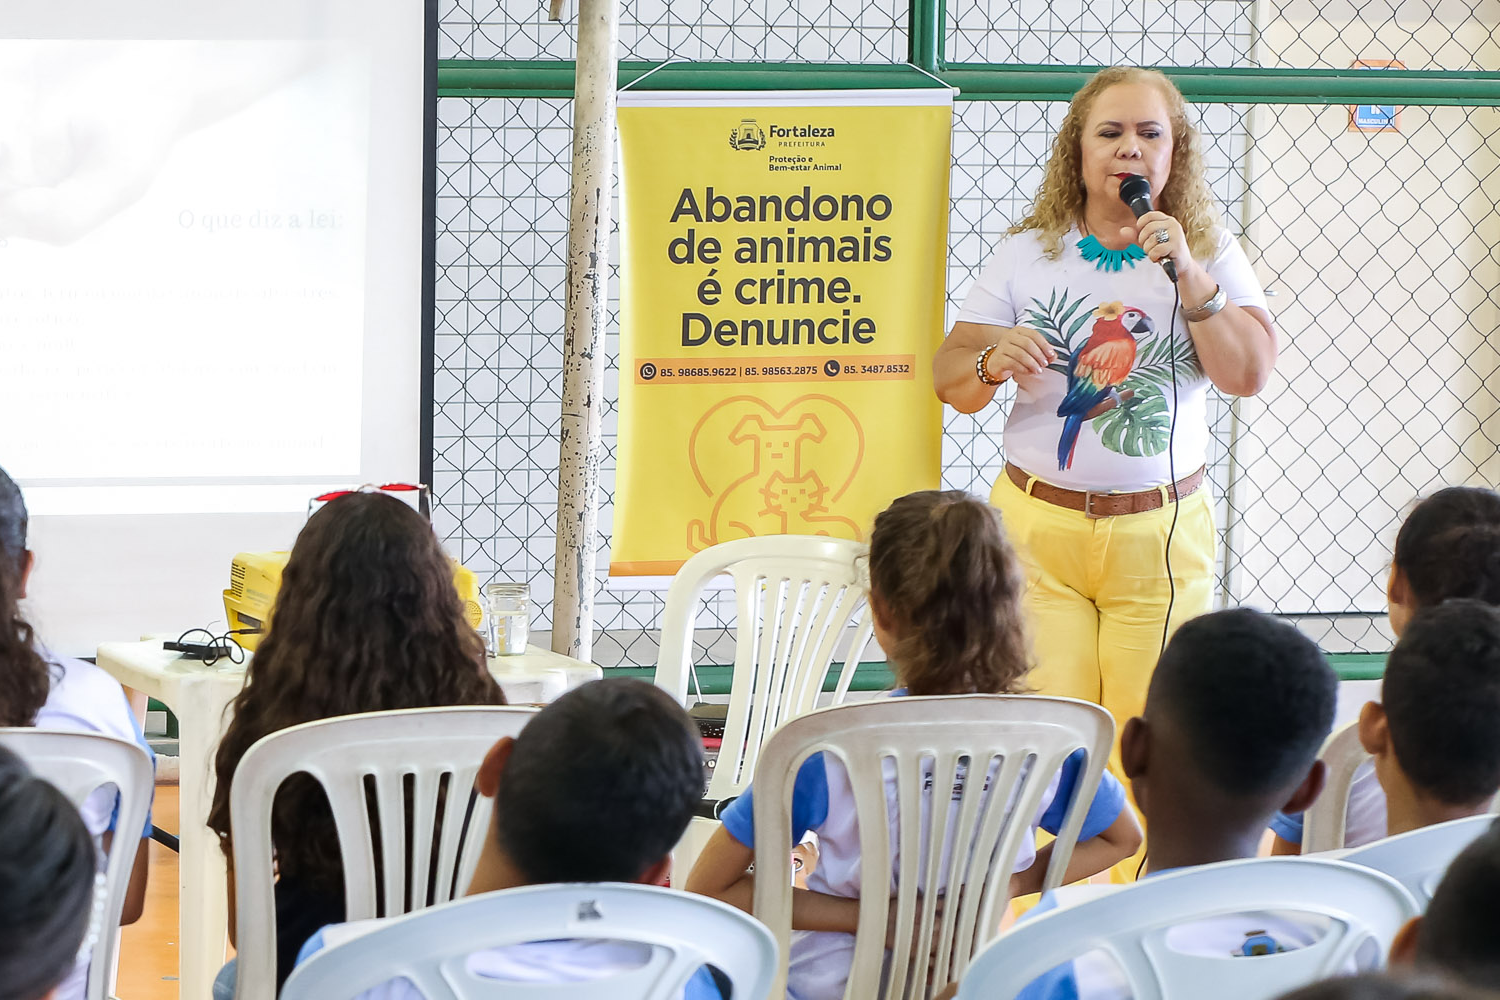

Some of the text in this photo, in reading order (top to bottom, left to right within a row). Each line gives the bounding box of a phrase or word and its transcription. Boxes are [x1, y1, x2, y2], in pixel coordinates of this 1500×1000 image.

[769, 124, 835, 138] Fortaleza
[769, 155, 806, 164] Proteção
[769, 163, 842, 172] Bem-estar Animal
[669, 186, 893, 224] Abandono
[178, 208, 195, 229] O
[202, 213, 242, 233] que
[249, 208, 283, 229] diz
[288, 213, 302, 229] a
[667, 226, 893, 265] de animais
[697, 268, 862, 306] é crime.
[680, 309, 877, 348] Denuncie
[660, 368, 675, 377] 85.
[678, 367, 737, 377] 98685.9622
[744, 367, 760, 376] 85.
[761, 365, 818, 376] 98563.2875
[843, 365, 858, 374] 85.
[860, 364, 910, 374] 3487.8532
